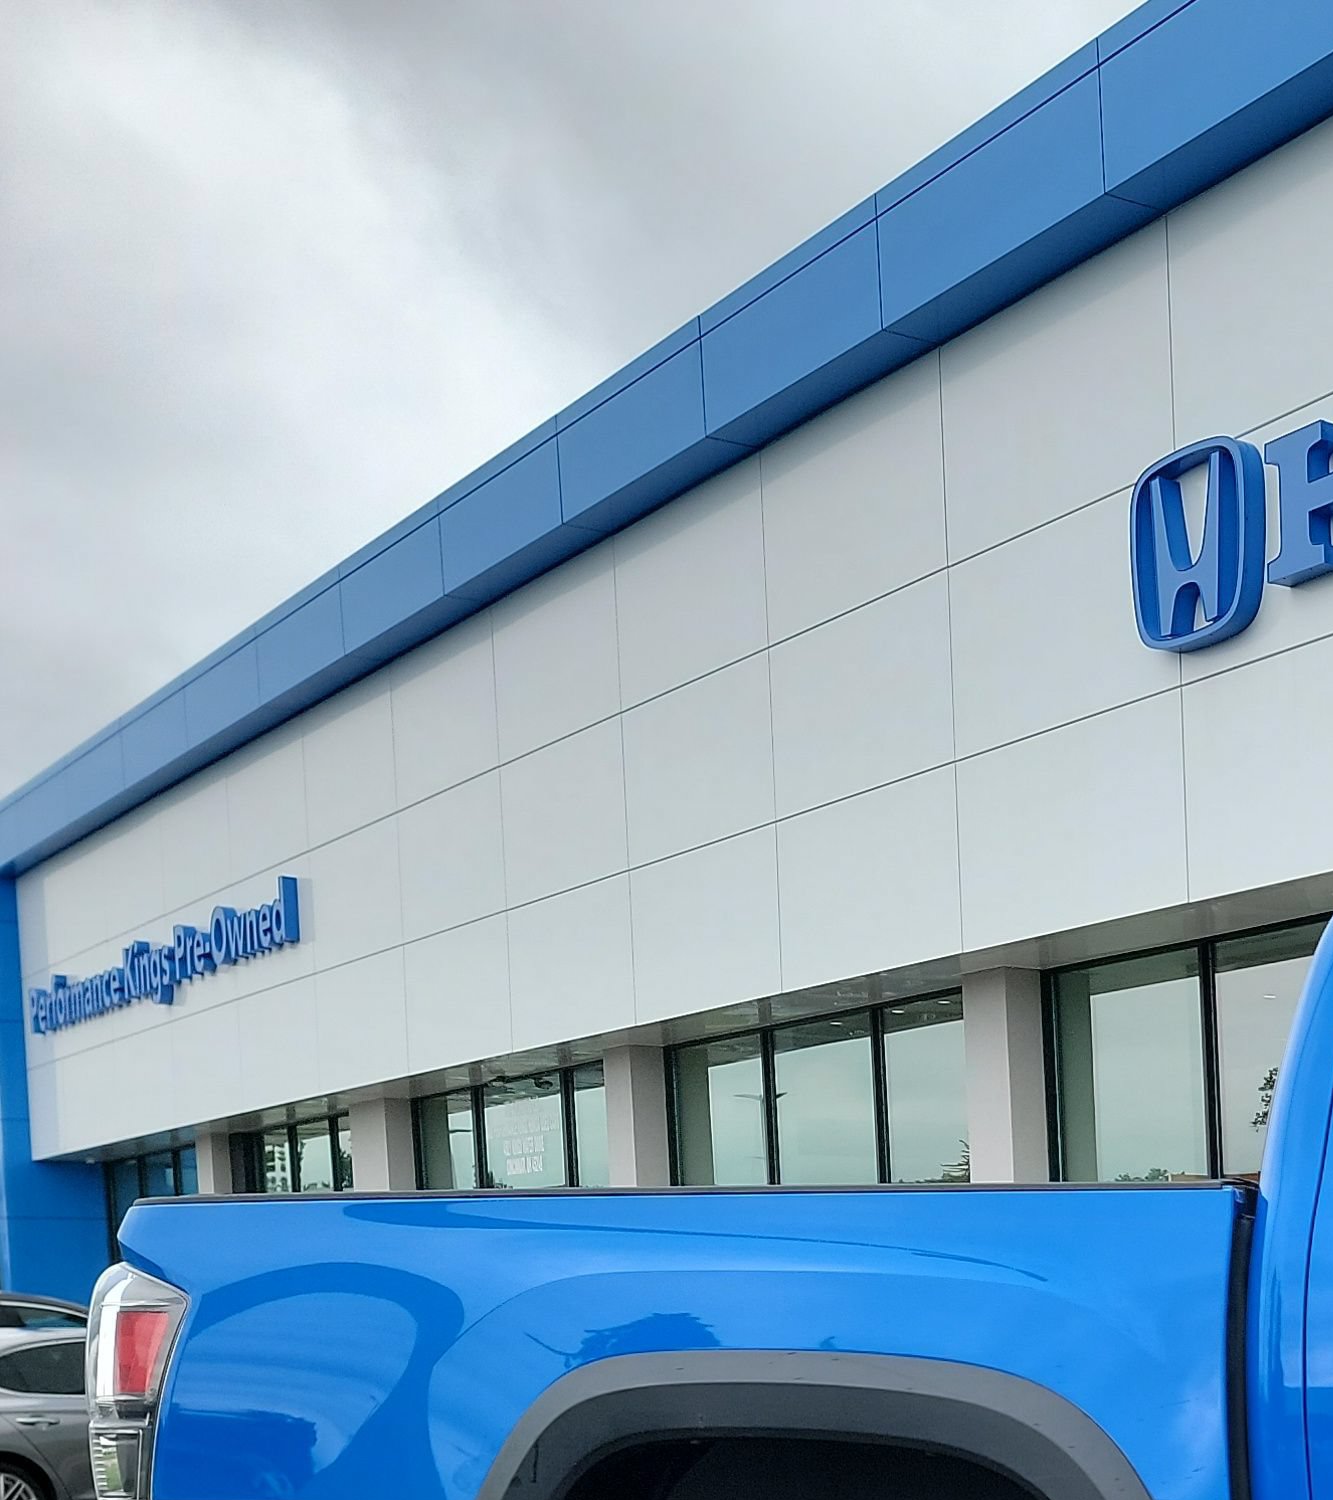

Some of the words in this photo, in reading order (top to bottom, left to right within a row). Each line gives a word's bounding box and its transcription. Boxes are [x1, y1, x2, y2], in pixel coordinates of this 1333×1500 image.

[30, 970, 123, 1033] Performance
[122, 941, 175, 1004] Kings
[173, 875, 300, 984] Pre-Owned
